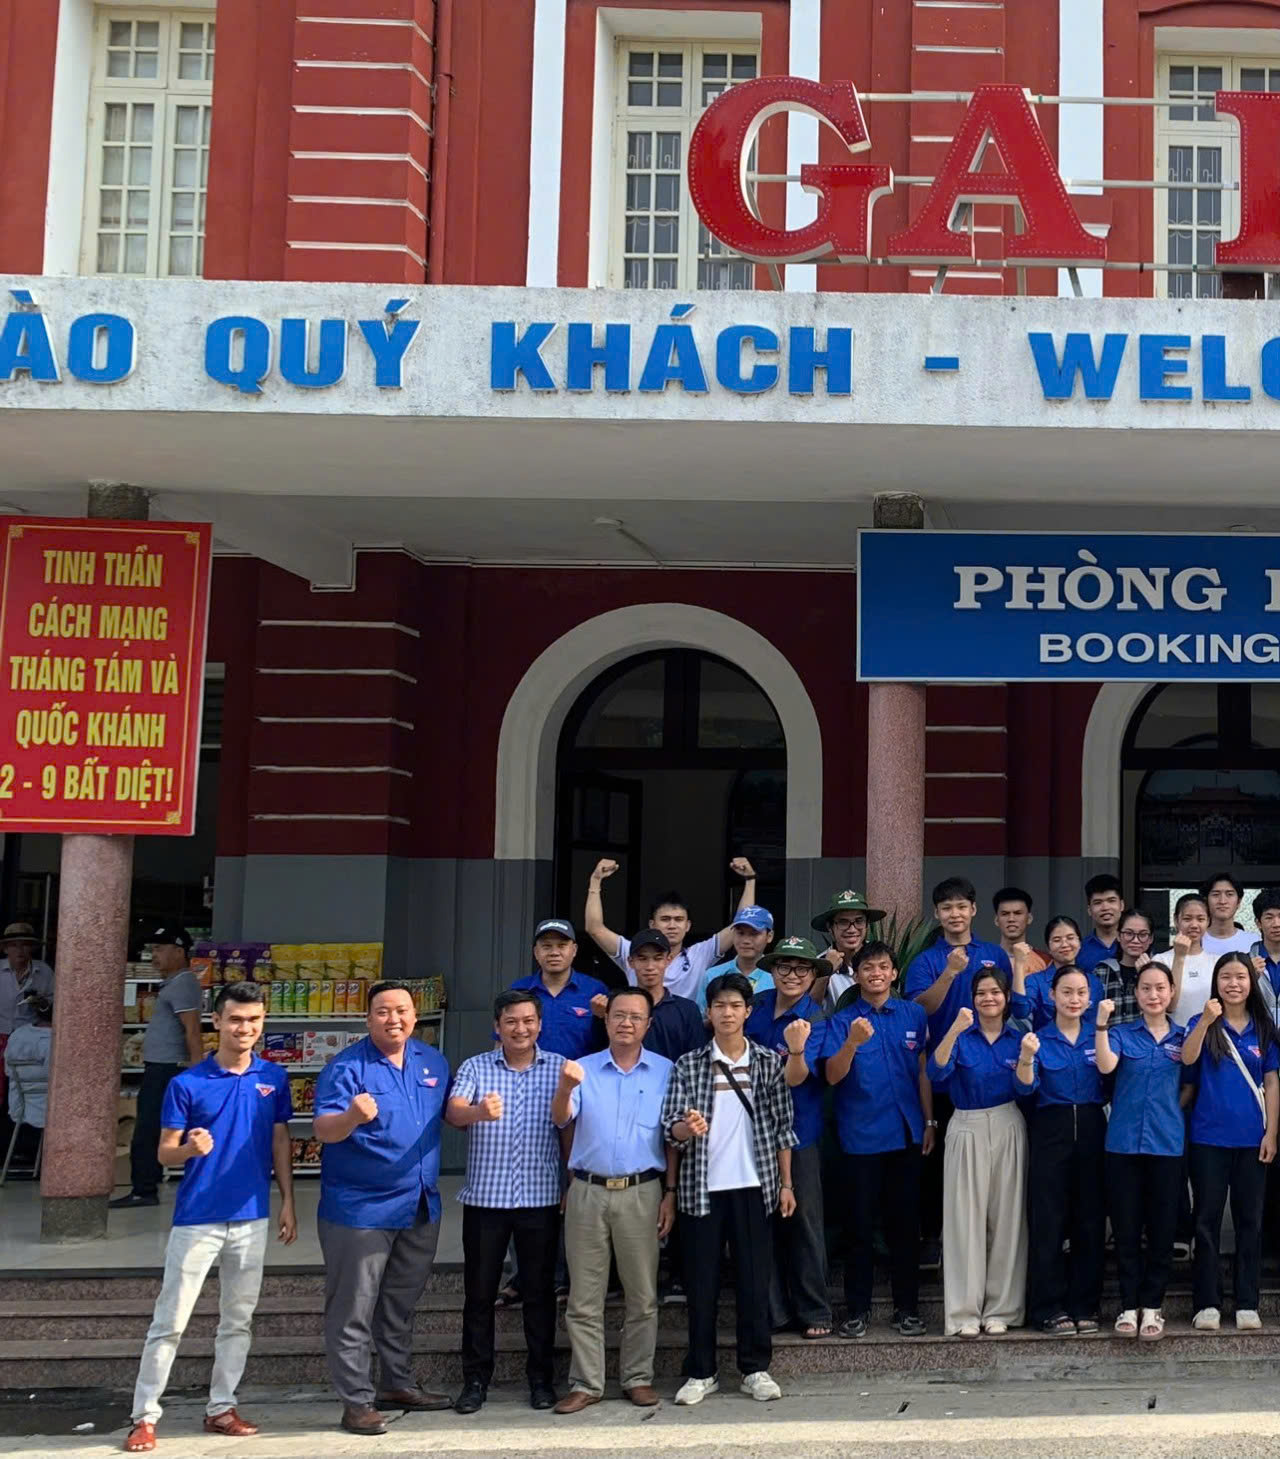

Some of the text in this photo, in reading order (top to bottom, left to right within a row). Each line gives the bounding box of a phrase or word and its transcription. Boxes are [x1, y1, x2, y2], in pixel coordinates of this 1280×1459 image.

[687, 74, 1110, 267] GA
[204, 298, 421, 393] QUÝ
[490, 303, 853, 395] KHÁCH
[43, 545, 163, 587] TINH THẦN
[953, 549, 1228, 611] PHÒNG
[28, 598, 168, 647] CÁCH MẠNG
[9, 649, 179, 694] THÁNG TÁM VÀ
[1039, 633, 1280, 664] BOOKING
[15, 703, 166, 748] QUỐC KHÁNH
[0, 764, 15, 799] 2
[42, 765, 57, 800] 9
[63, 757, 109, 801] BẤT
[115, 759, 173, 809] DIỆT!
